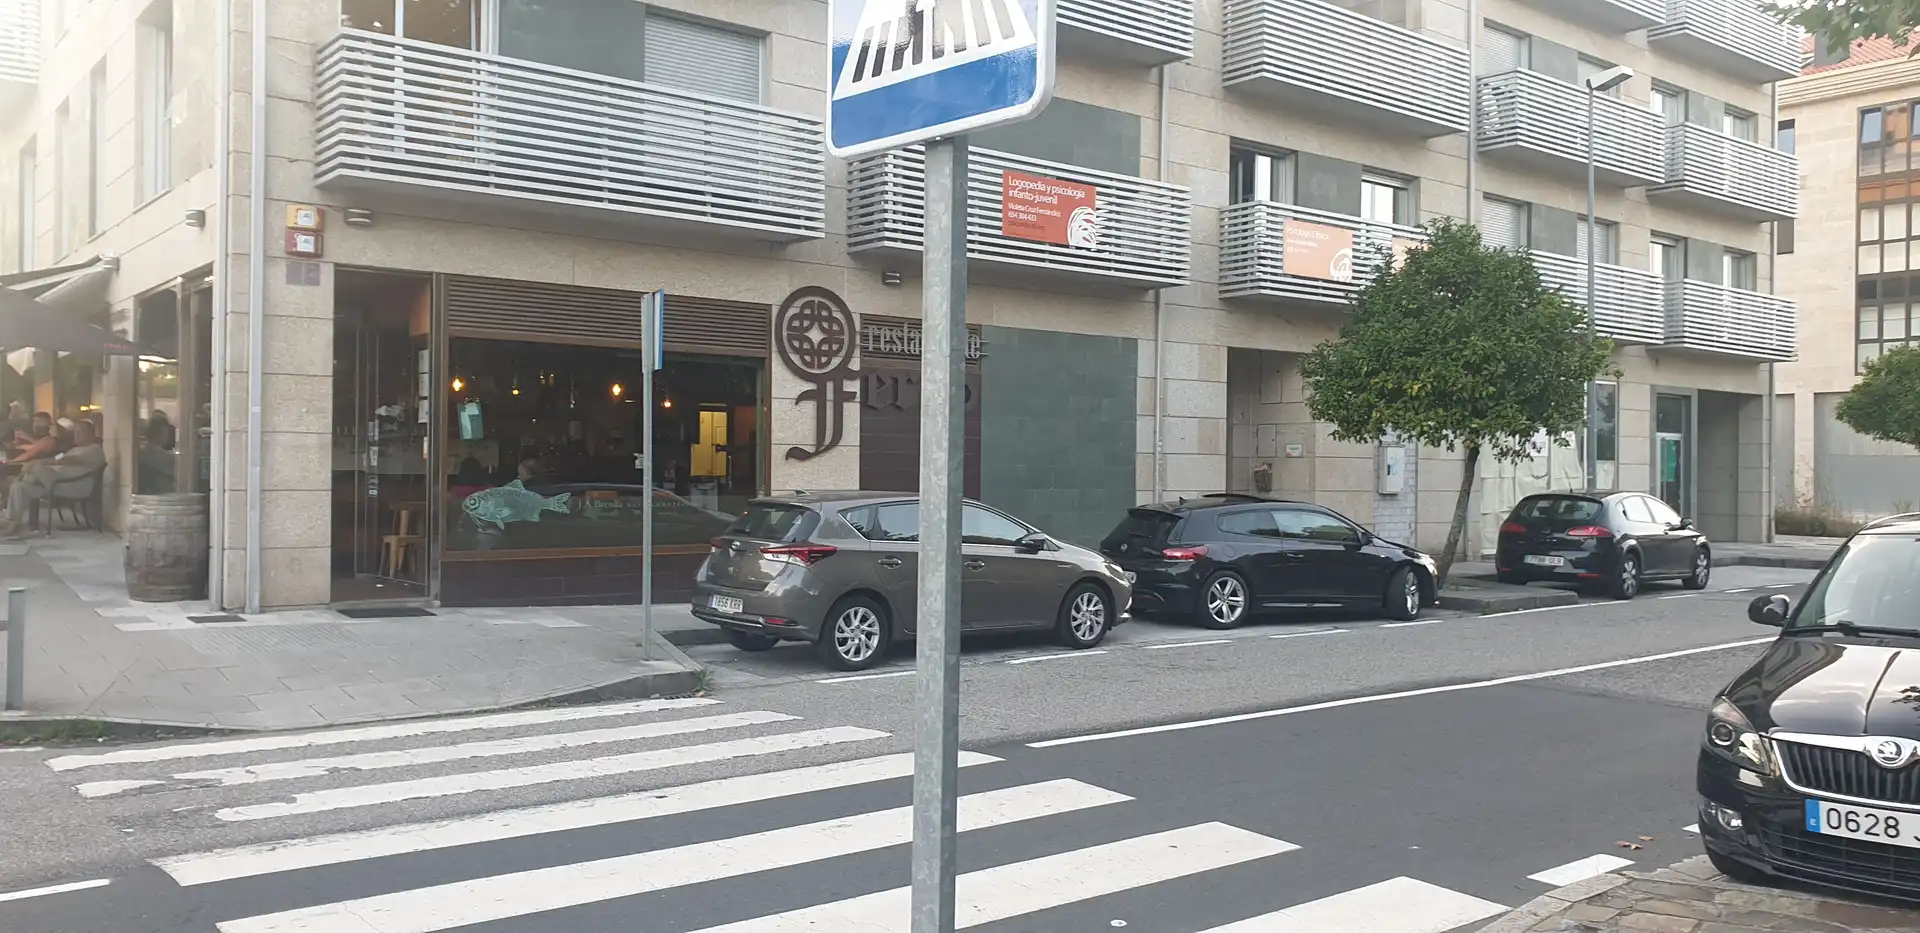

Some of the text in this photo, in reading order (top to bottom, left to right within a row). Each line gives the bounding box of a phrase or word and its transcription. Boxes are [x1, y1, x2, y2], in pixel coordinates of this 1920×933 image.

[1008, 176, 1046, 191] Logopedia
[1046, 186, 1052, 194] y
[1008, 188, 1058, 204] infanto-juvenil
[866, 322, 980, 358] restae
[1827, 808, 1900, 838] 0628
